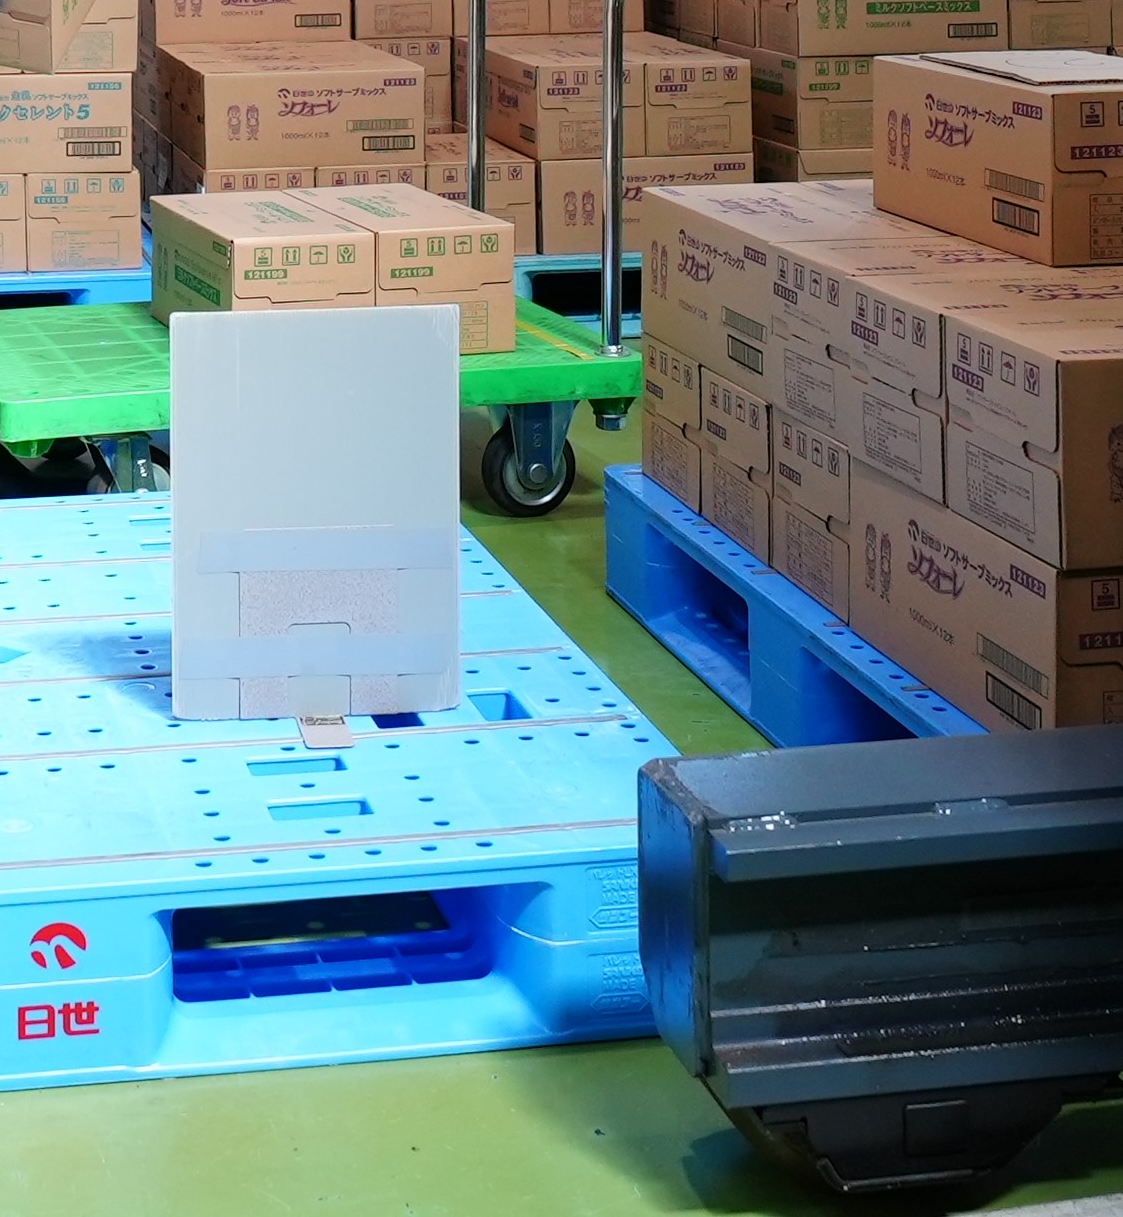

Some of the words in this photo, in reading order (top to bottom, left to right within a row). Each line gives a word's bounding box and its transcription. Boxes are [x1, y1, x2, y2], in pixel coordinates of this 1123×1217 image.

[955, 103, 1016, 129] ソフトサーブミックス
[1014, 103, 1042, 119] 121123
[1089, 104, 1096, 115] 5
[1074, 147, 1123, 159] 121123
[701, 241, 746, 271] ソフトサーブミックス
[943, 544, 1014, 598] ソフトサーブミックス
[1012, 566, 1045, 597] 121123
[18, 1001, 100, 1040] 日世
